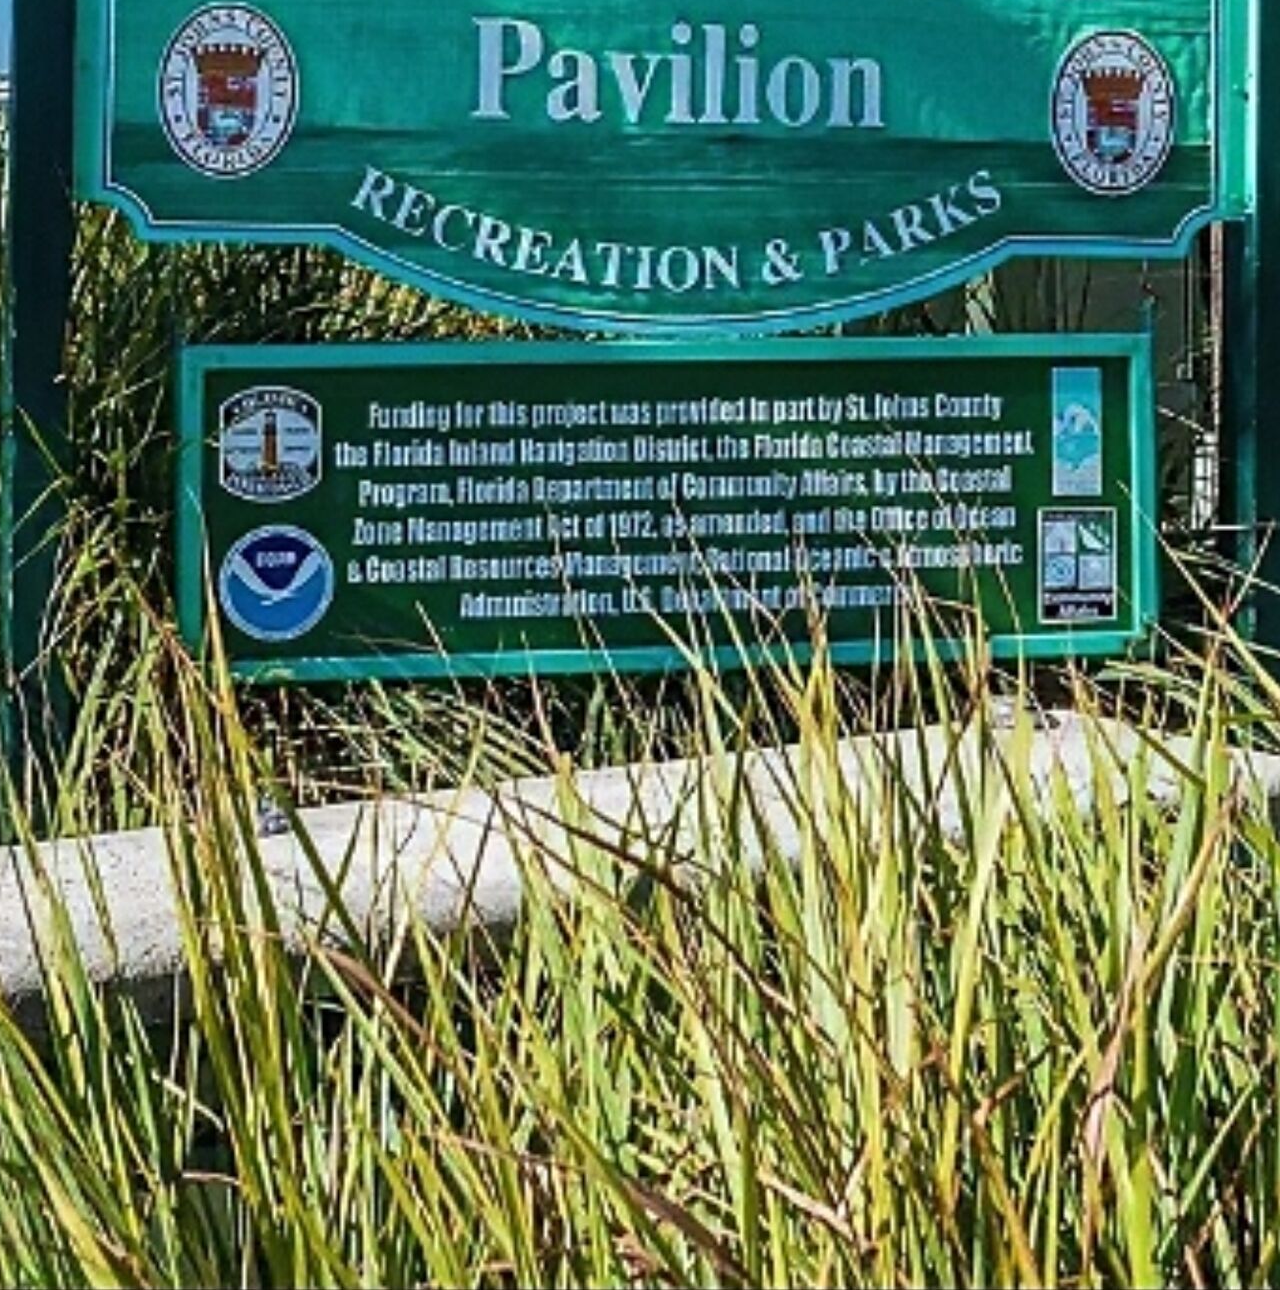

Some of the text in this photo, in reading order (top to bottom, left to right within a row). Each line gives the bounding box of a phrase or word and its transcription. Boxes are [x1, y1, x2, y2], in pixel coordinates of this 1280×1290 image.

[471, 16, 884, 129] Pavilion
[350, 165, 1002, 290] RECREATION & PARKS
[368, 401, 451, 432] Funding
[455, 401, 484, 428] for
[487, 400, 528, 426] this
[531, 400, 607, 428] project
[610, 403, 651, 426] was
[655, 396, 744, 427] provided
[819, 396, 843, 424] by
[874, 394, 929, 421] Johns
[934, 394, 1003, 421] County
[335, 441, 367, 467] the
[373, 438, 446, 466] Florida
[449, 438, 515, 466] Inland
[519, 436, 628, 465] Navigation
[717, 433, 749, 459] the
[753, 431, 822, 459] Florida
[825, 431, 903, 458] Coastal
[456, 476, 529, 504] Florida
[531, 474, 654, 504] Department
[681, 471, 797, 500] Community
[352, 517, 403, 545] Zone
[406, 514, 543, 545] Management
[365, 555, 446, 583] Coastal
